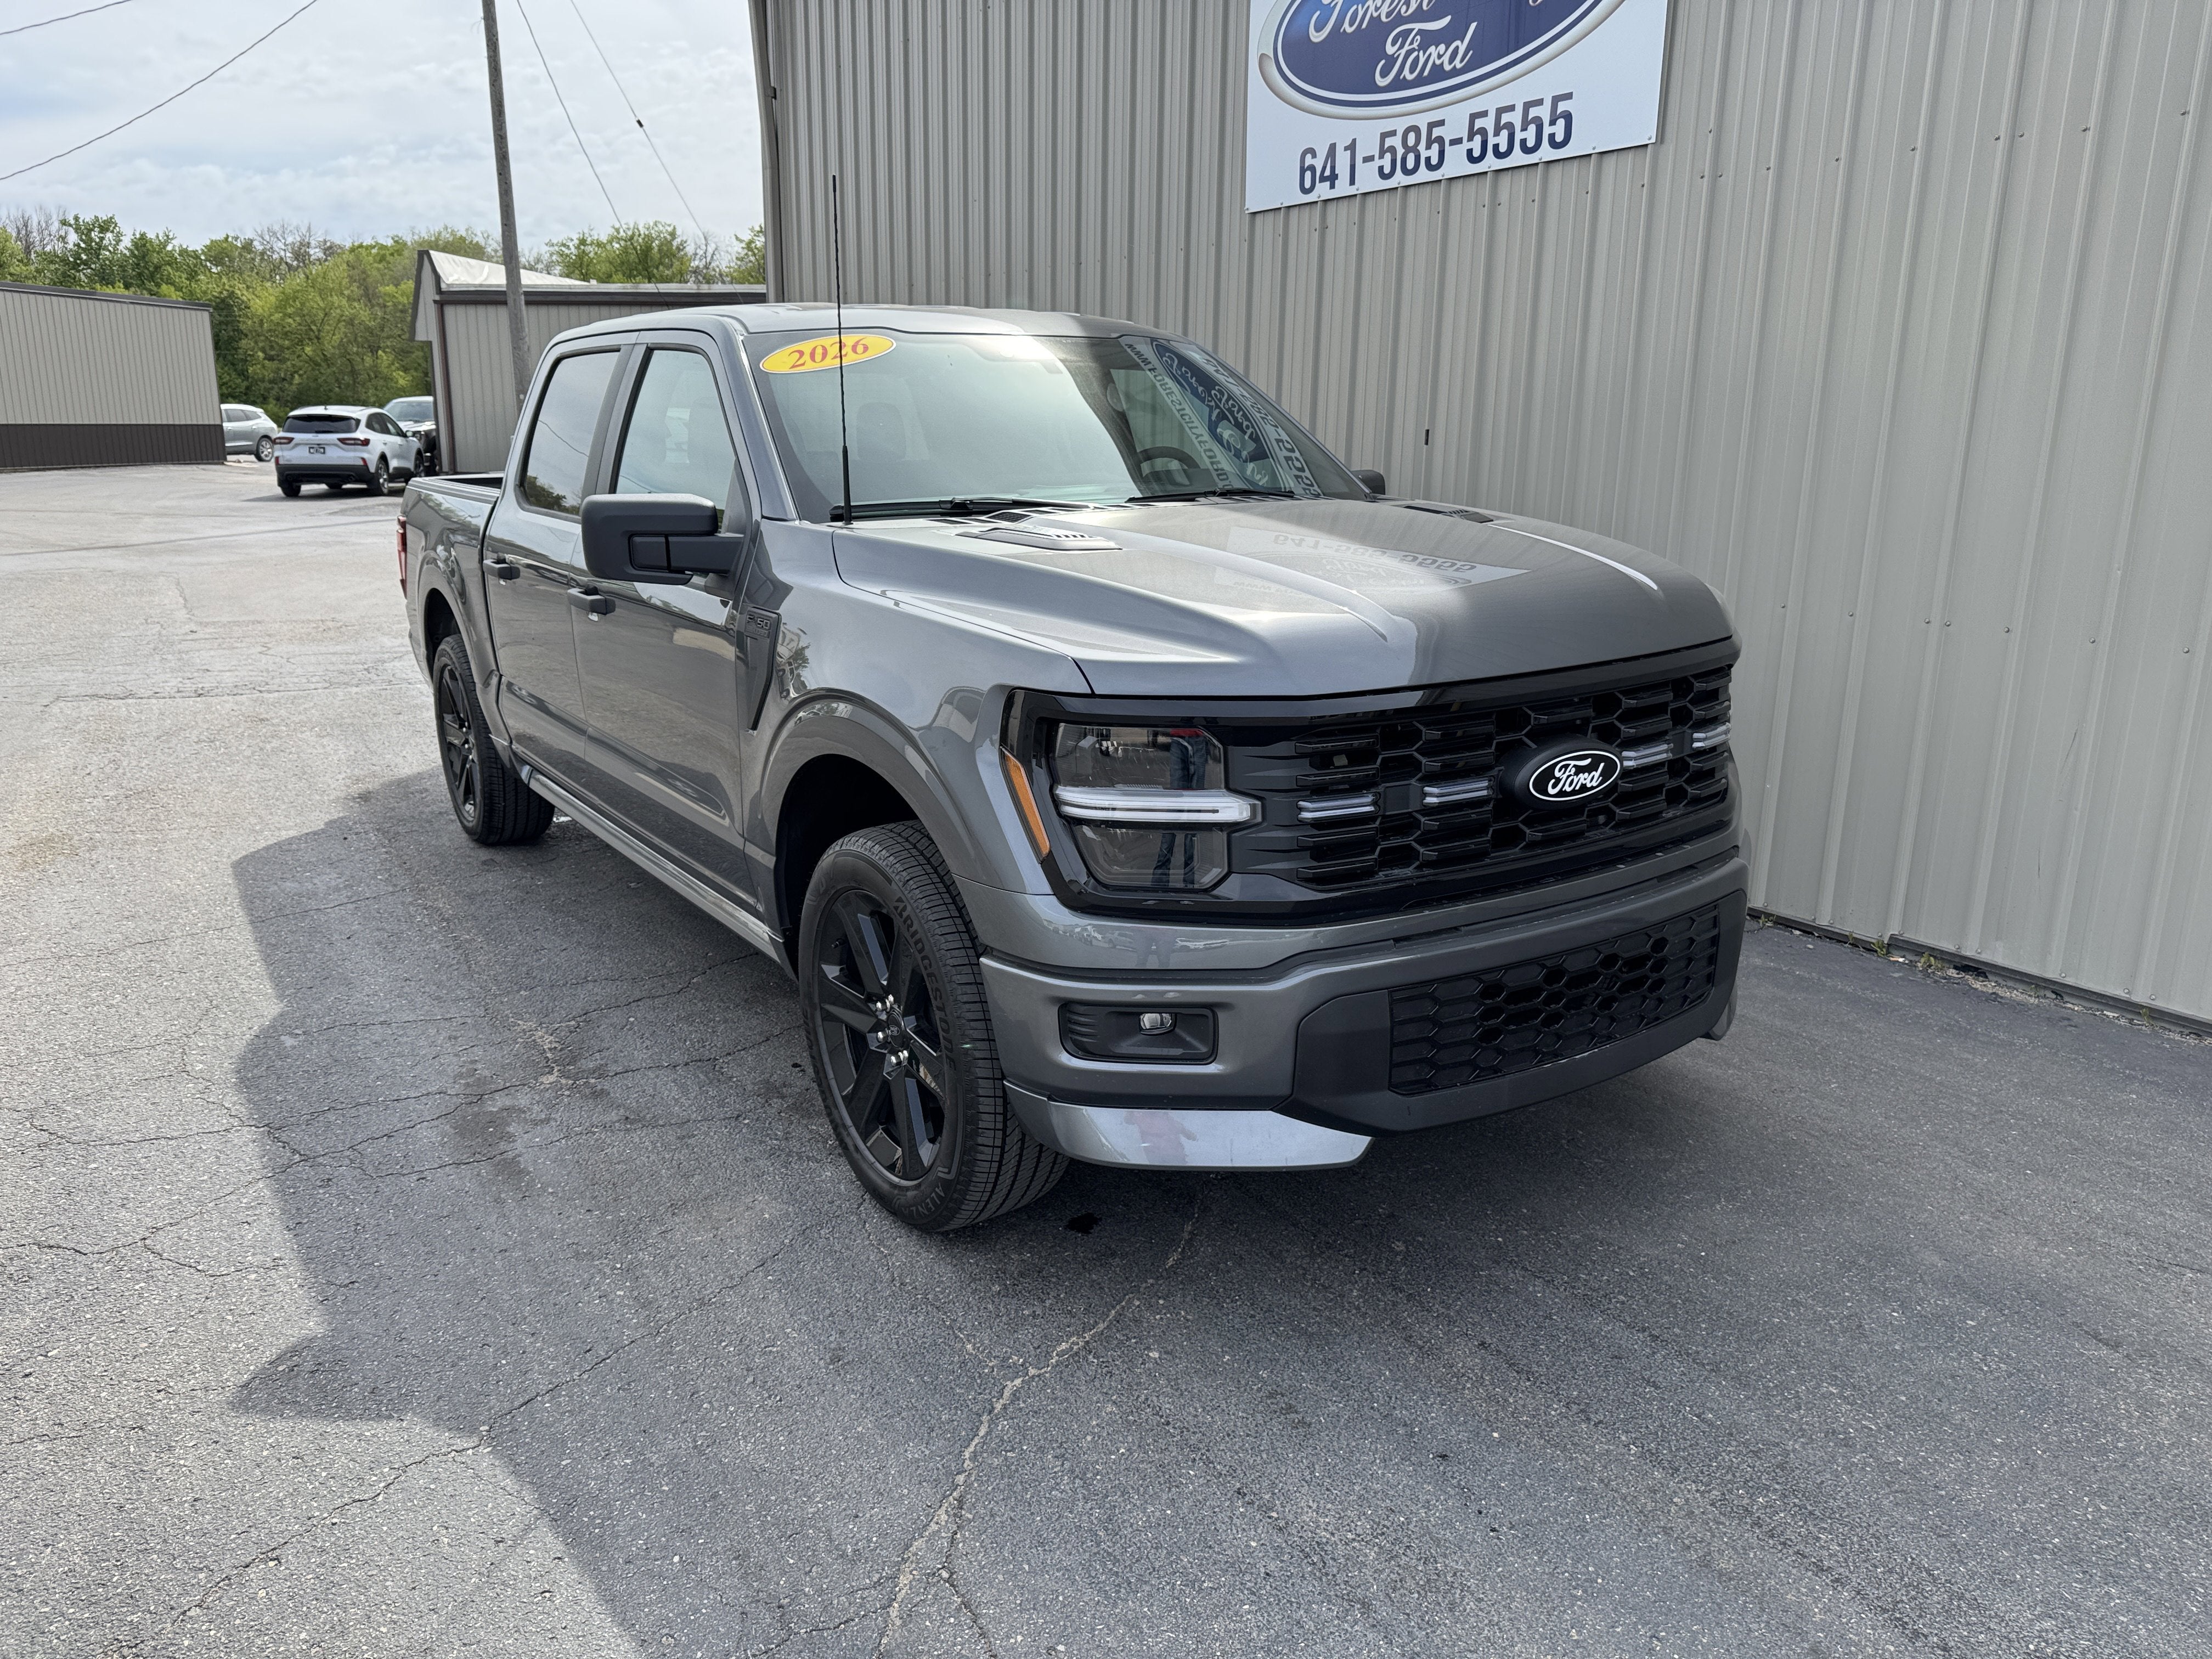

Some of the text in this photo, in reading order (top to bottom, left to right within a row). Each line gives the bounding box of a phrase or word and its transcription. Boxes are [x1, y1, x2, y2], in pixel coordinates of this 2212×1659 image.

[1309, 0, 1436, 43] Fores
[1375, 15, 1478, 87] Ford
[1299, 91, 1573, 195] 641-585-5555
[788, 336, 869, 370] 2026
[1548, 758, 1605, 795] Ford
[894, 896, 956, 1070] BRIDGESTONE
